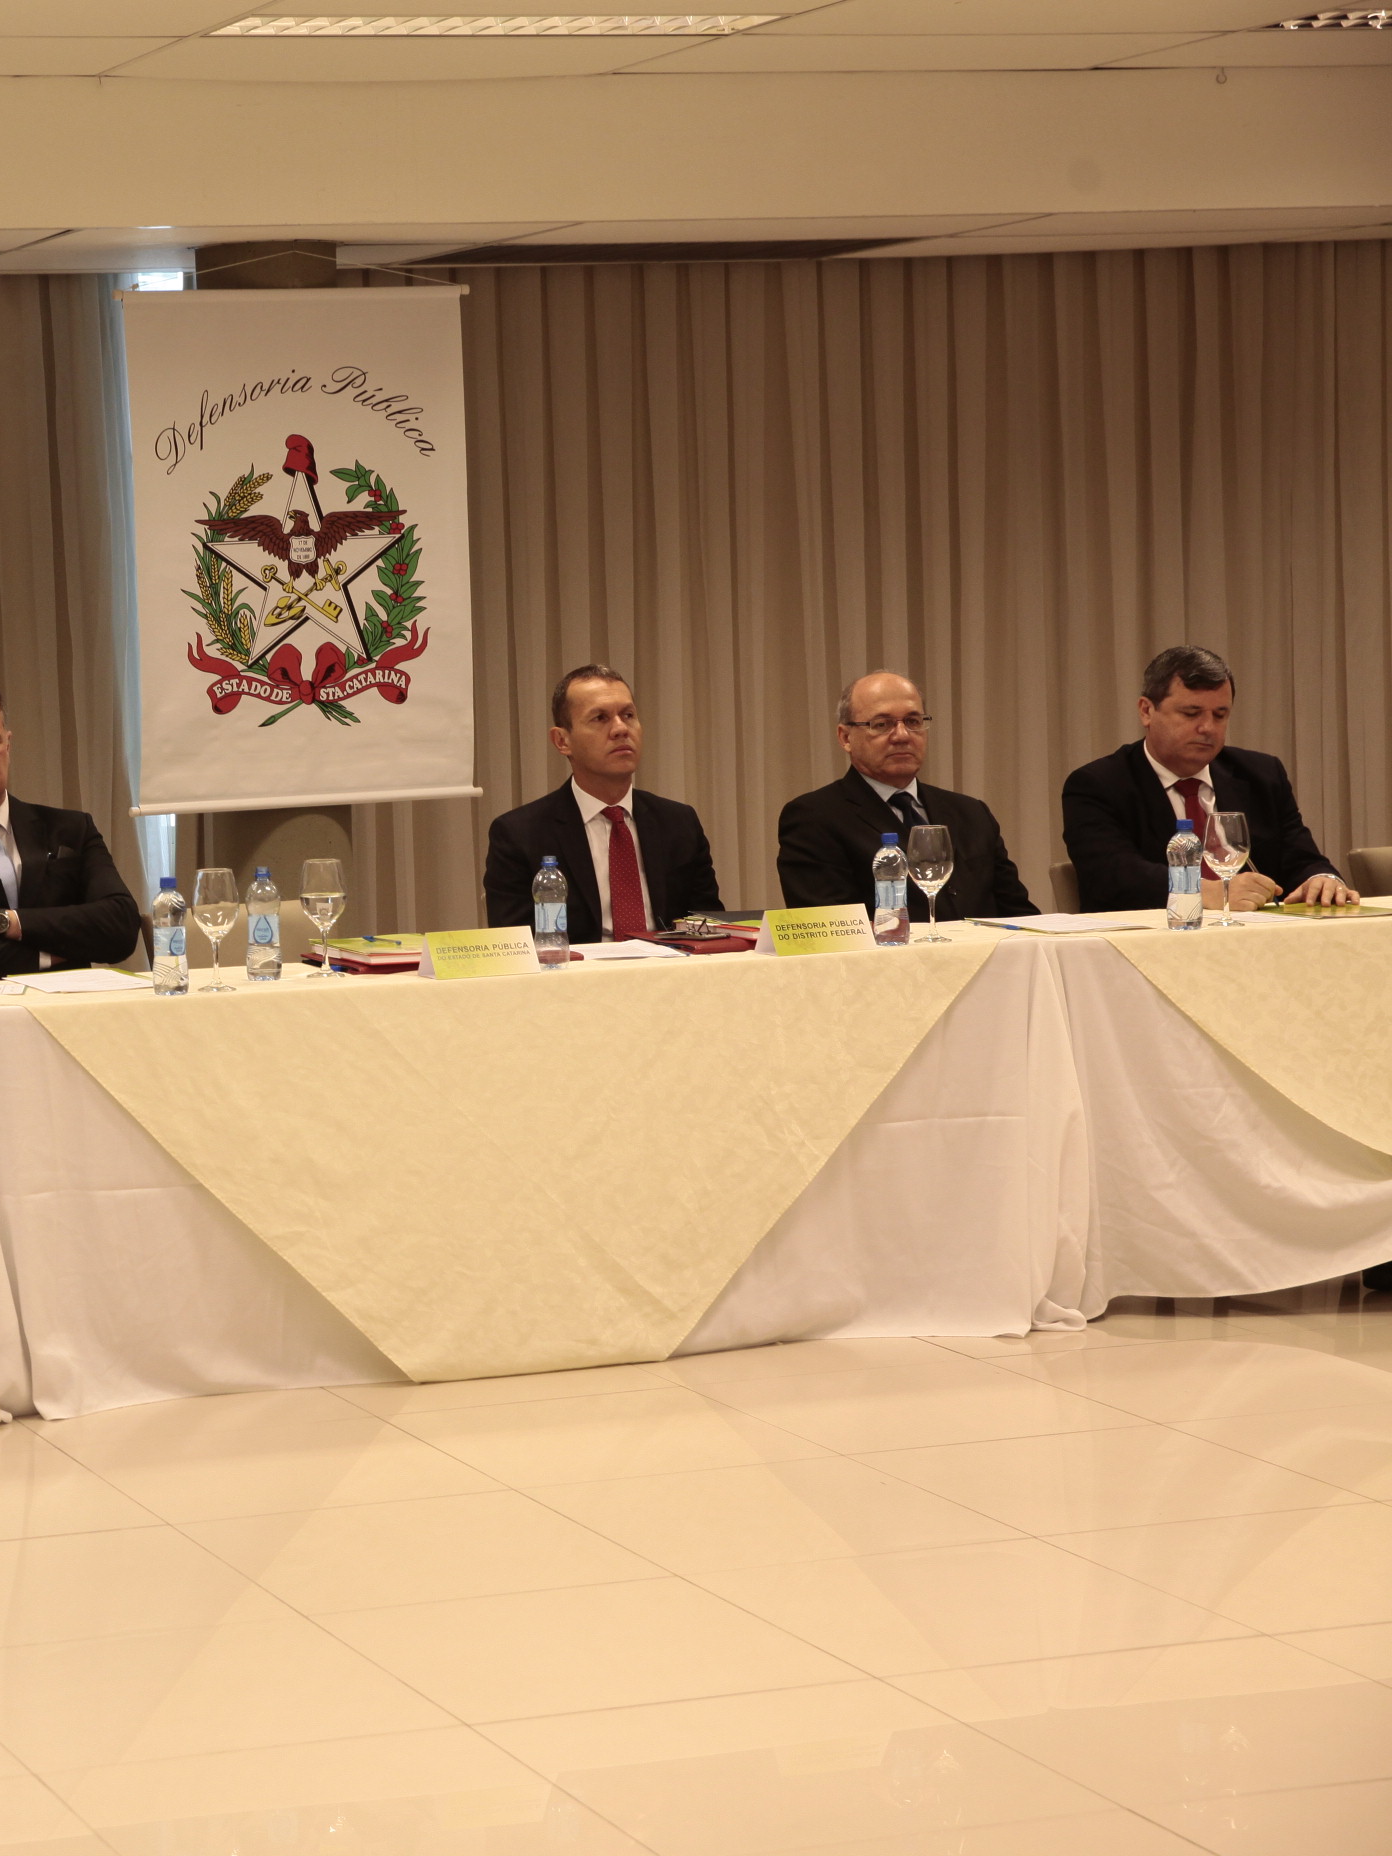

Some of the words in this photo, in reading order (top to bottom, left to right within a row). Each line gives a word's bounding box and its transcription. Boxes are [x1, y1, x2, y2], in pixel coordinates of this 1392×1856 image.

[155, 369, 312, 475] Defensoria
[320, 366, 436, 457] Pública
[213, 678, 270, 699] ESTADO
[270, 688, 292, 702] DE
[775, 922, 827, 932] DEFENSORIA
[792, 930, 828, 940] DISTRITO
[830, 928, 867, 937] FEDERAL
[436, 945, 490, 955] DEFENSORIA
